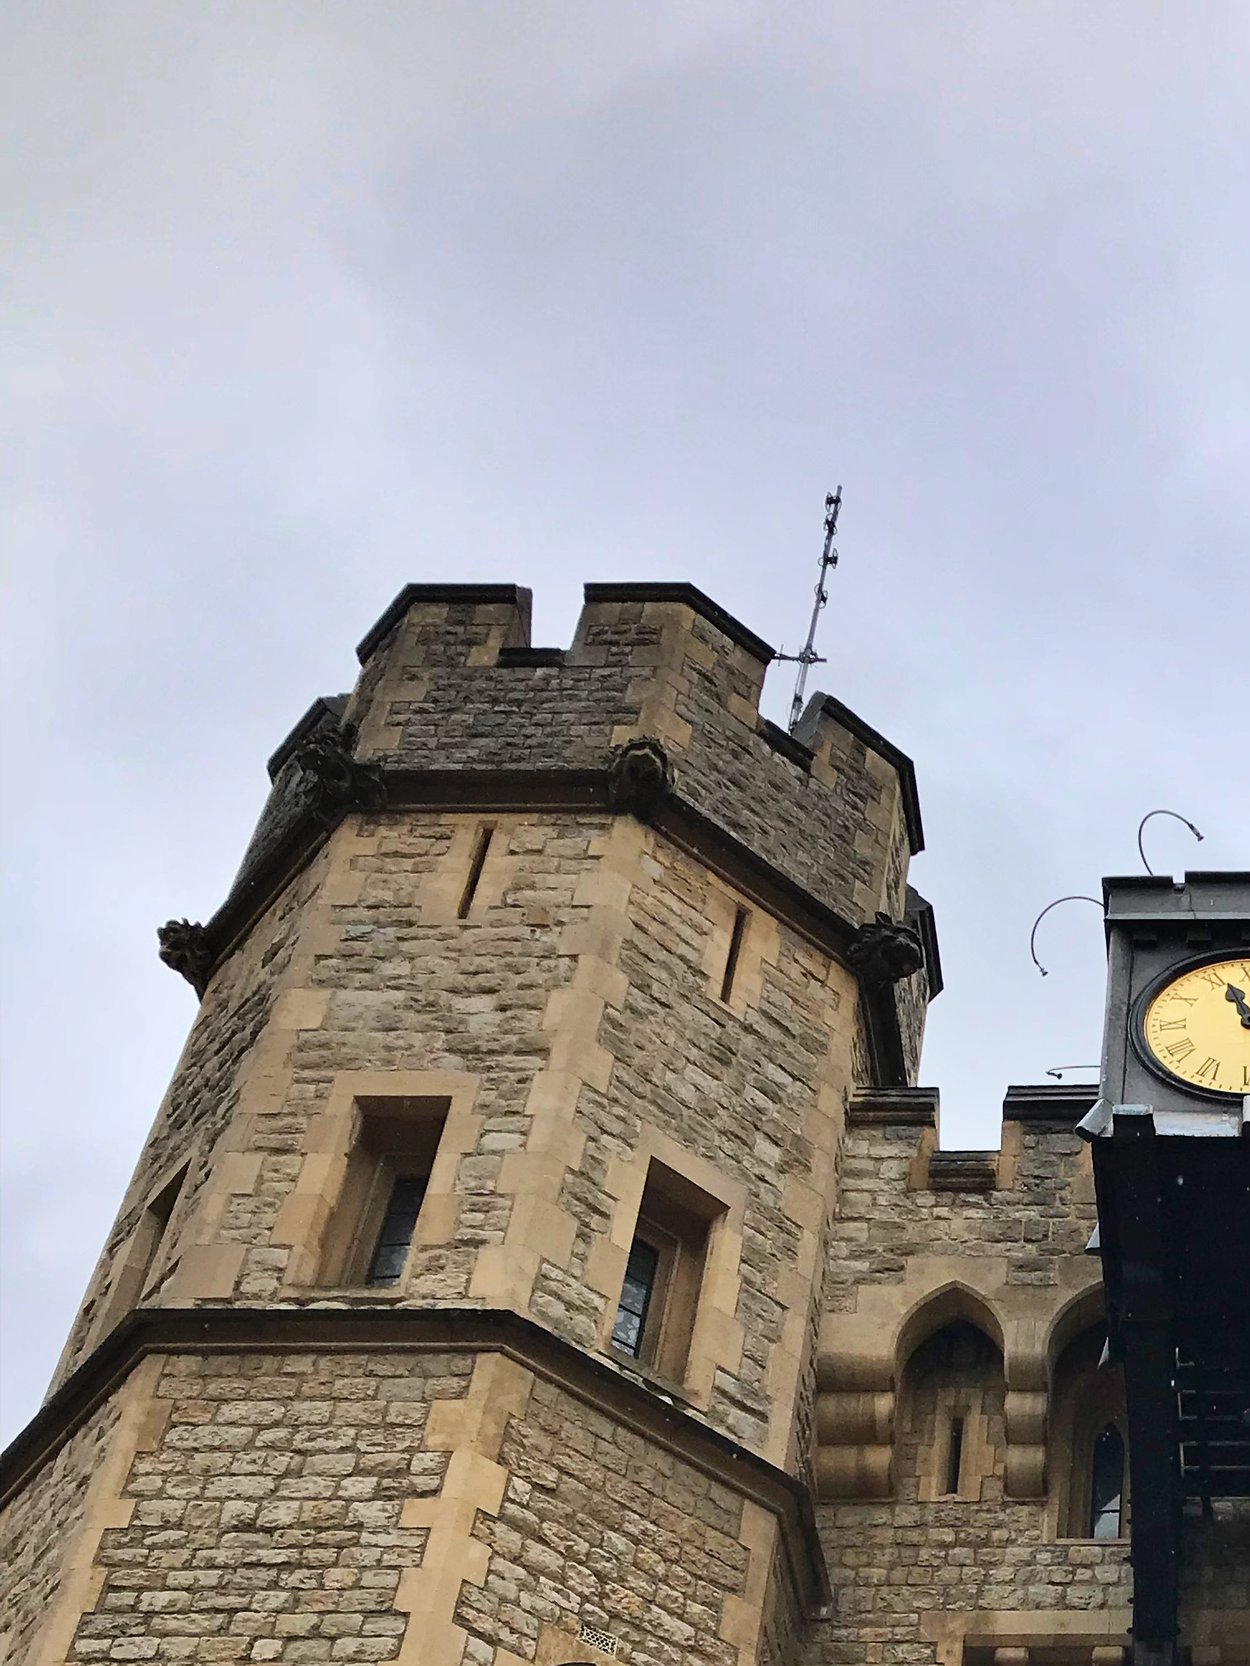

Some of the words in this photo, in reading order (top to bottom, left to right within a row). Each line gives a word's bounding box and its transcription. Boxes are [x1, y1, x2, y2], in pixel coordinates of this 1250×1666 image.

[1201, 972, 1227, 991] XI
[1170, 992, 1199, 1007] X
[1159, 1018, 1187, 1032] IX
[1165, 1037, 1197, 1064] VIII
[1195, 1057, 1221, 1081] VII
